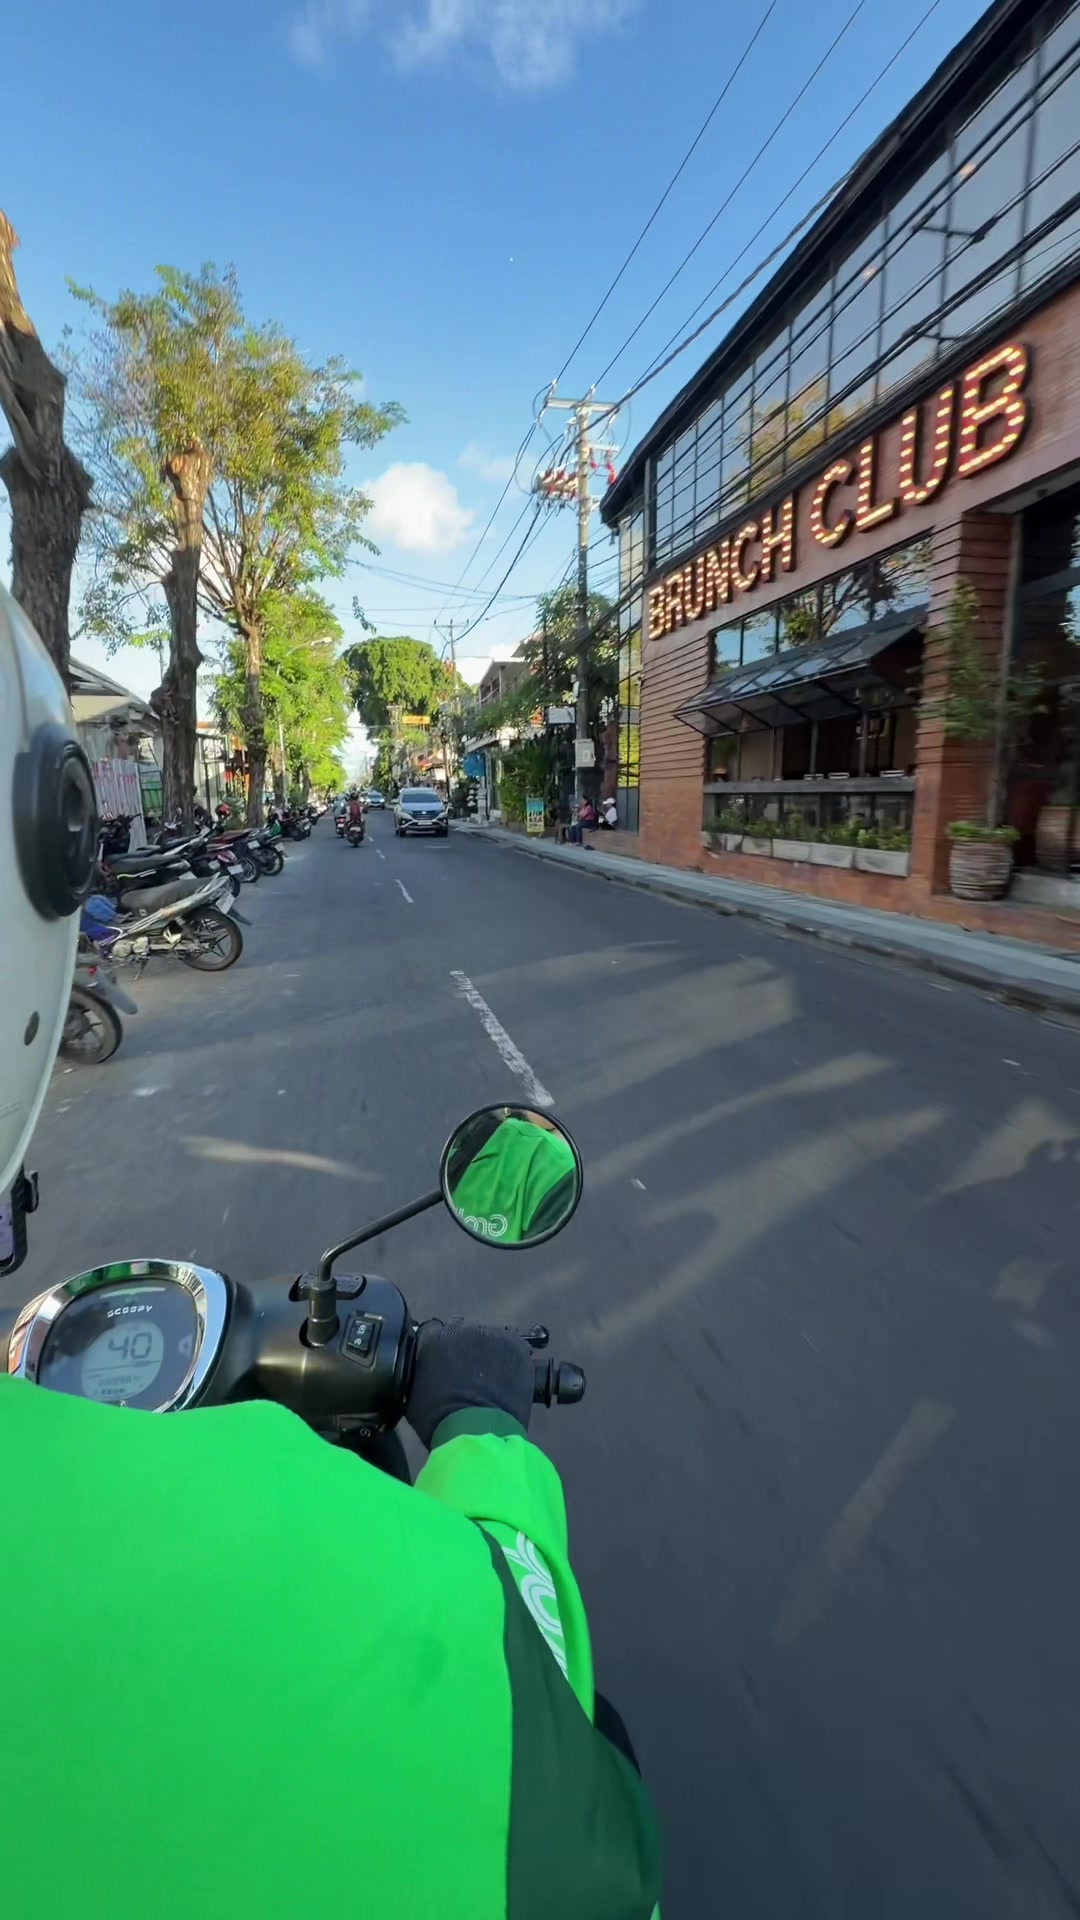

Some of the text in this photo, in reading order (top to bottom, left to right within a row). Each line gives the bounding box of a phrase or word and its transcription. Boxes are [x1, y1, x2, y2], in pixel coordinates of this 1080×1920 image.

[647, 341, 1032, 641] BRUNCH CLUB
[106, 1304, 153, 1318] SCOOPY
[108, 1332, 153, 1360] 40
